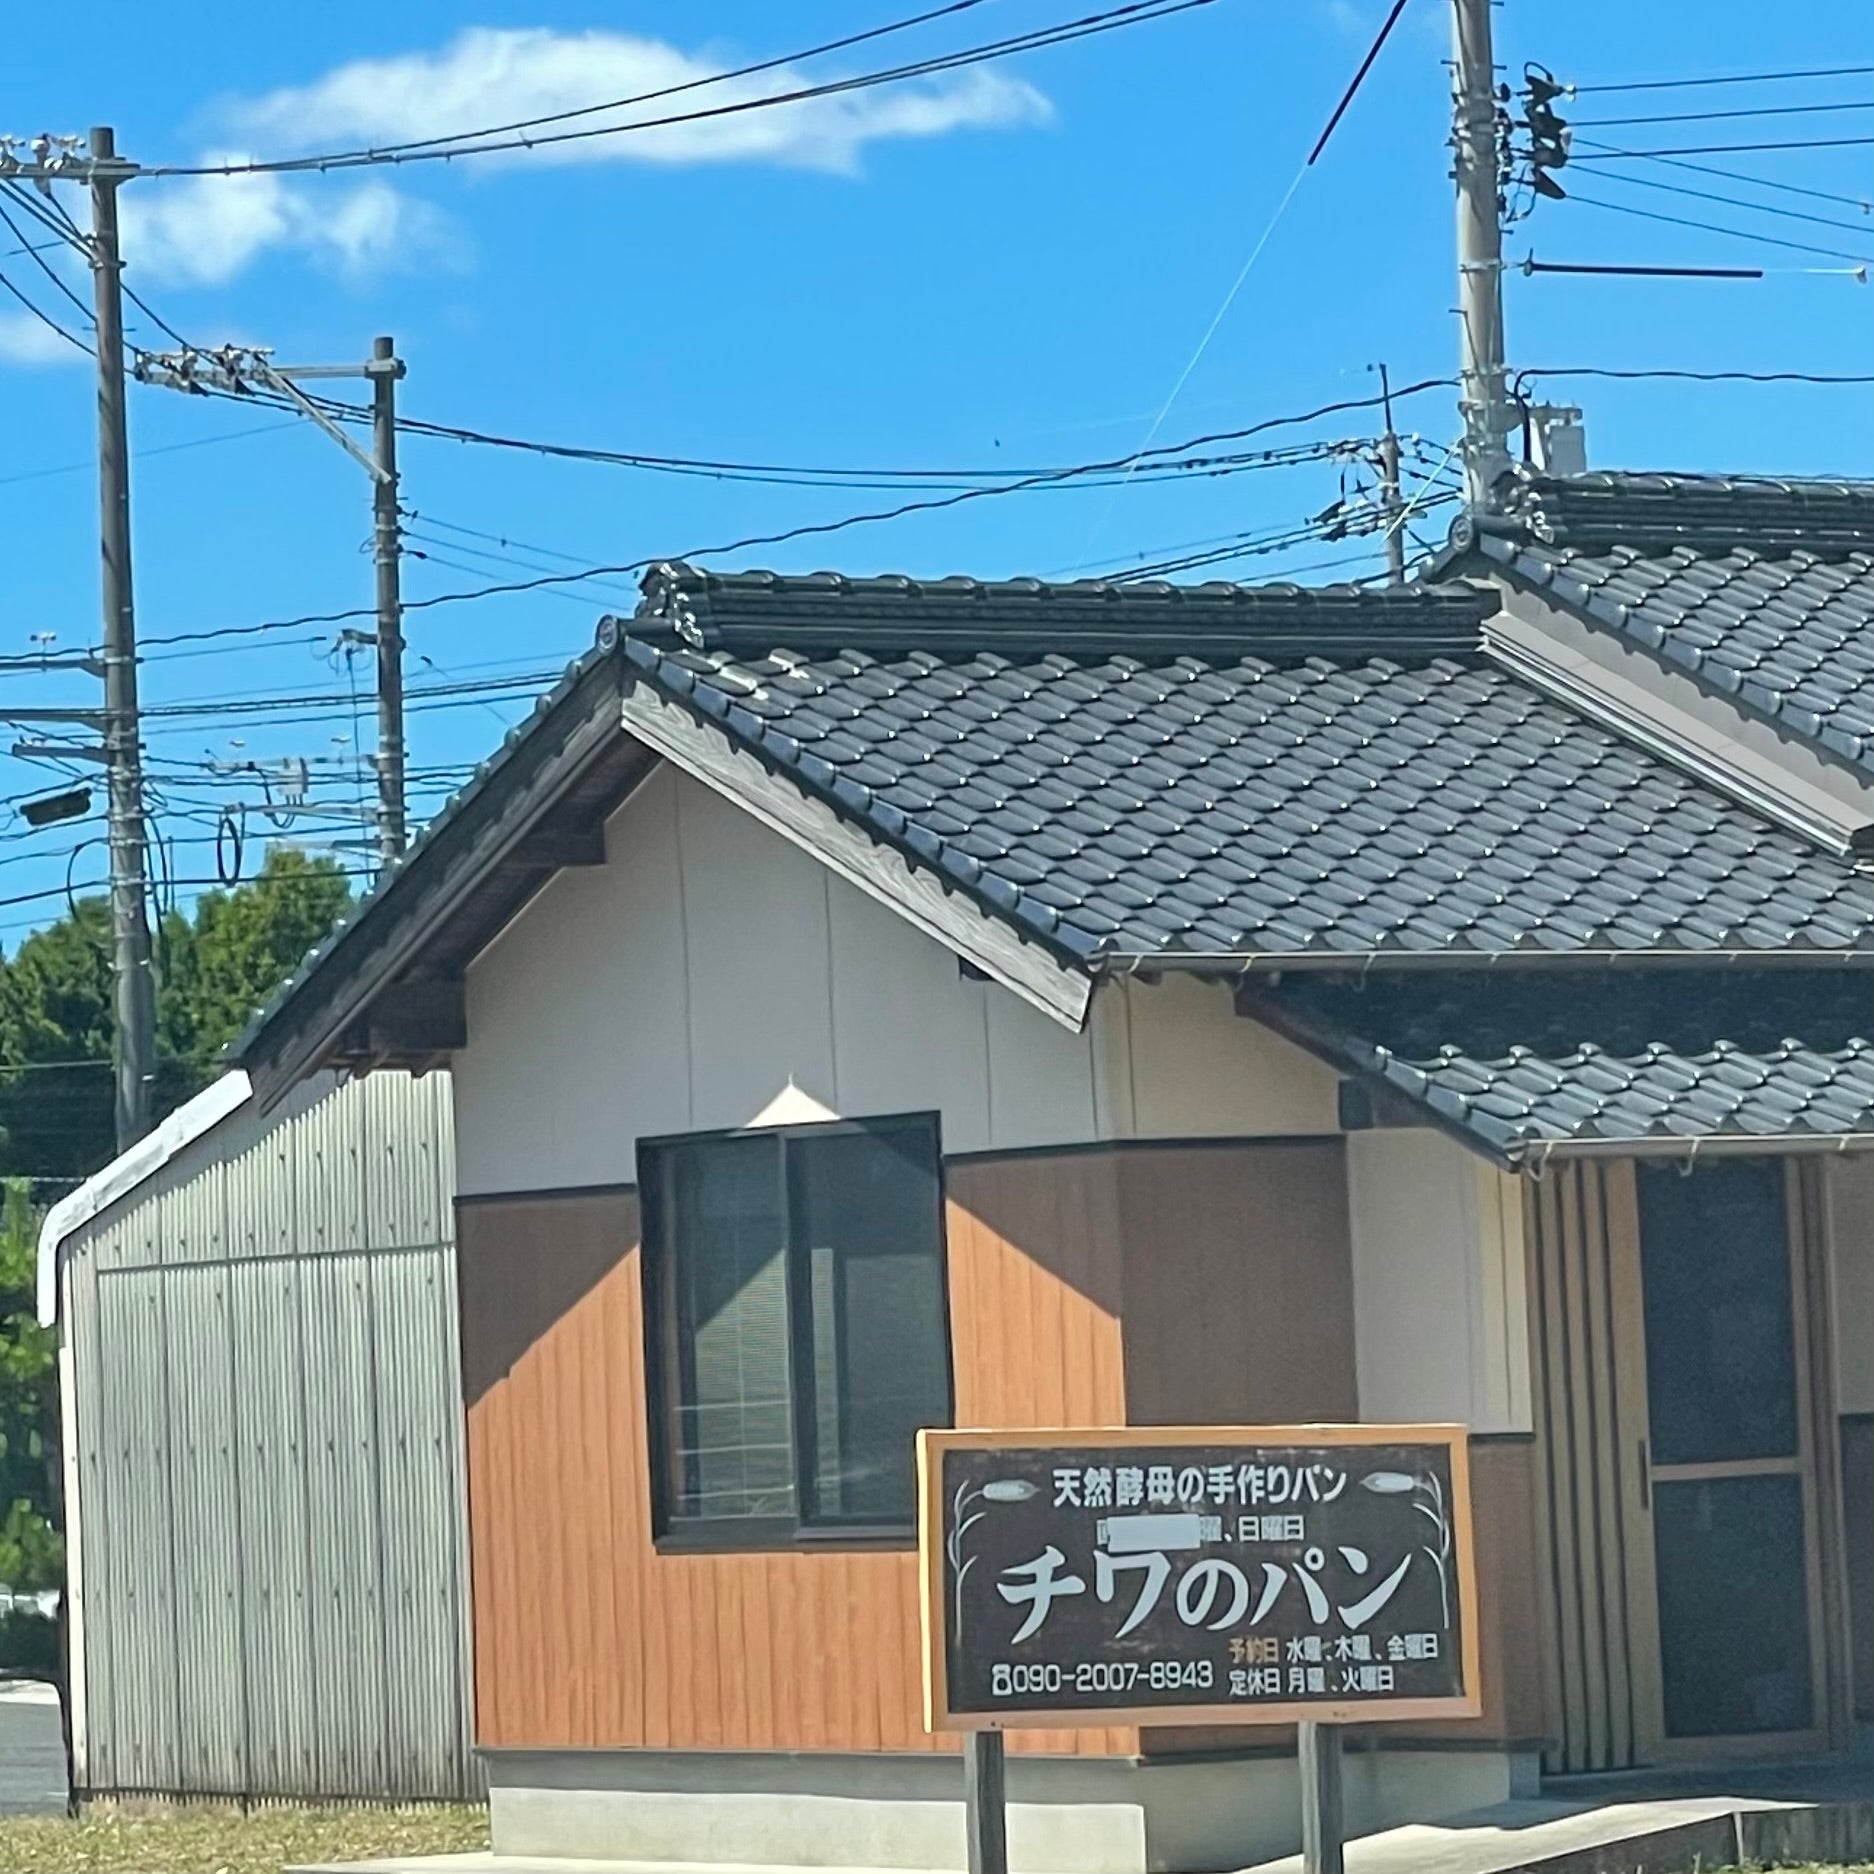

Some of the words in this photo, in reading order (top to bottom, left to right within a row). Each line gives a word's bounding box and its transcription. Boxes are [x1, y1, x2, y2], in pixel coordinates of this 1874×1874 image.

[1053, 1464, 1347, 1507] 天然酵母の手作りパン
[997, 1545, 1412, 1644] チワのパン
[1229, 1637, 1279, 1663] 予約日
[1012, 1660, 1213, 1692] 090-2007-8943
[1229, 1667, 1281, 1696] 定休日
